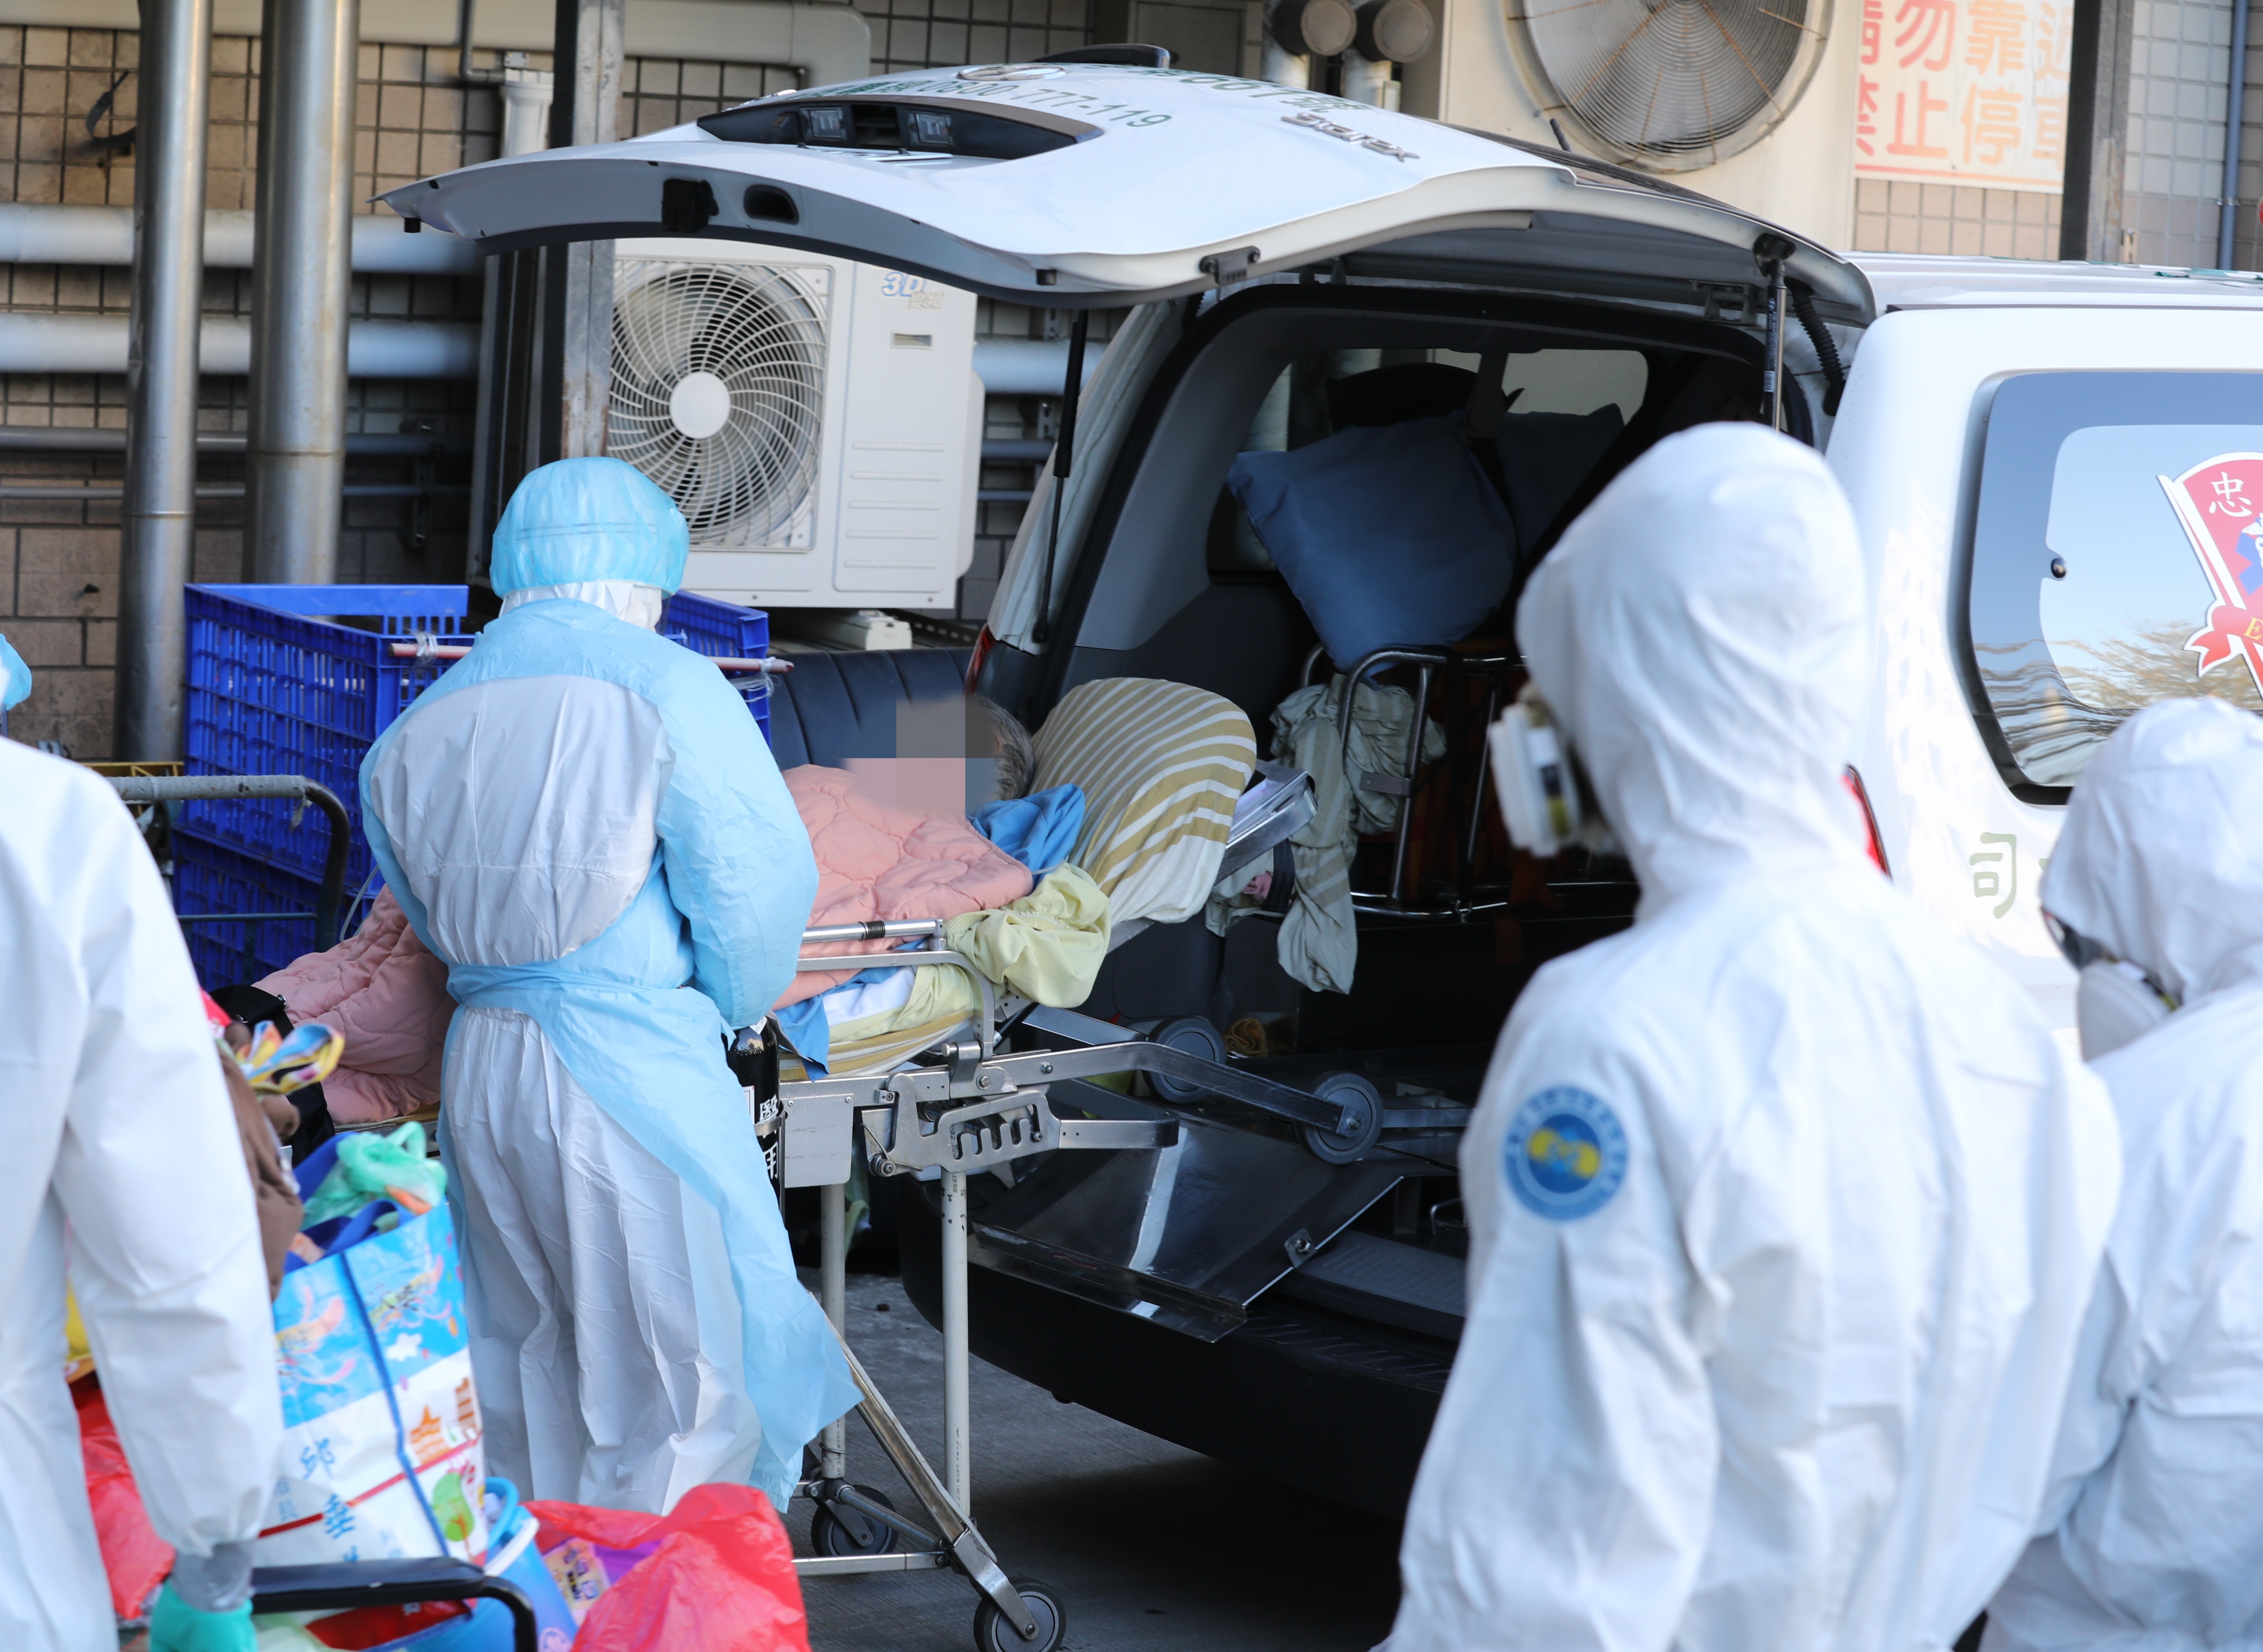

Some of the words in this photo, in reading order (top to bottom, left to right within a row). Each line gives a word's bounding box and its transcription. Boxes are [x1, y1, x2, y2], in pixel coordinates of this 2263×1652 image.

[1009, 88, 1172, 127] 777-119
[1280, 112, 1420, 163] Starex
[881, 271, 927, 297] 3D
[2209, 472, 2253, 517] 忠
[1970, 831, 2016, 919] 司
